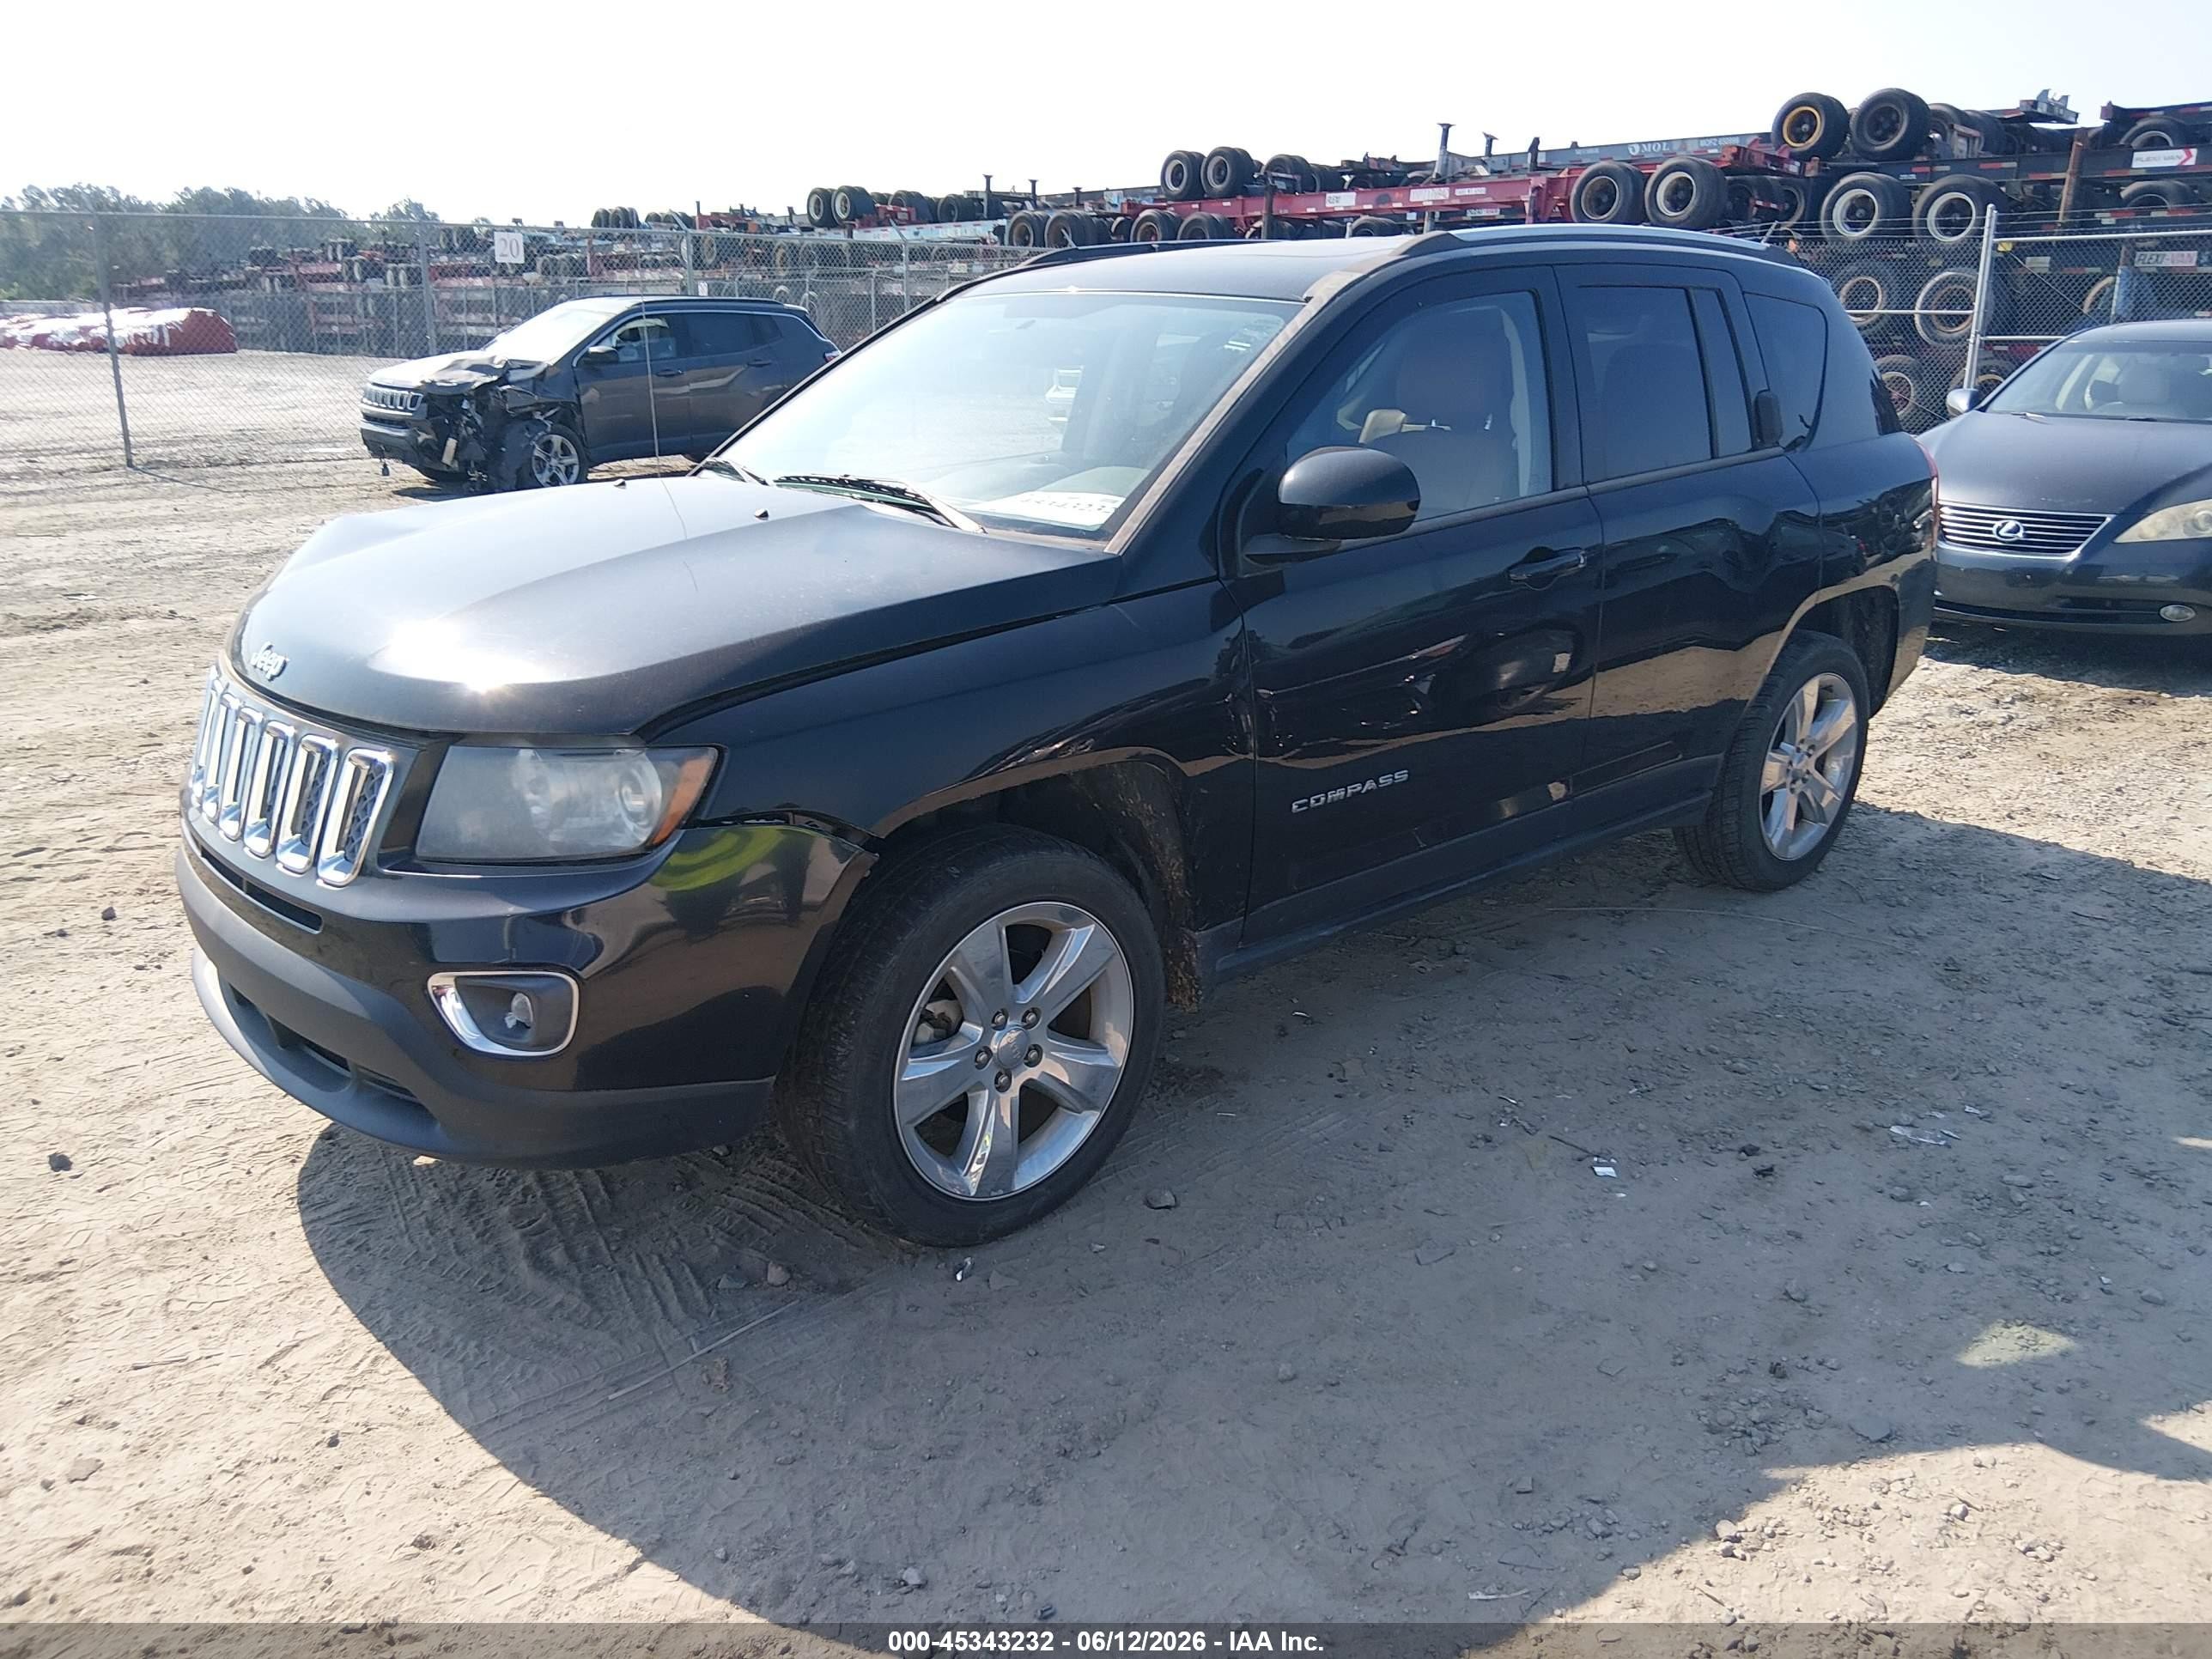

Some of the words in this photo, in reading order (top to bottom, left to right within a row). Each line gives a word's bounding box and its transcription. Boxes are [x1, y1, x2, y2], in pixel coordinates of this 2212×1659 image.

[1641, 142, 1670, 153] MOL
[499, 237, 520, 258] 20
[250, 641, 287, 680] Jeep
[1291, 769, 1409, 814] COMPASS
